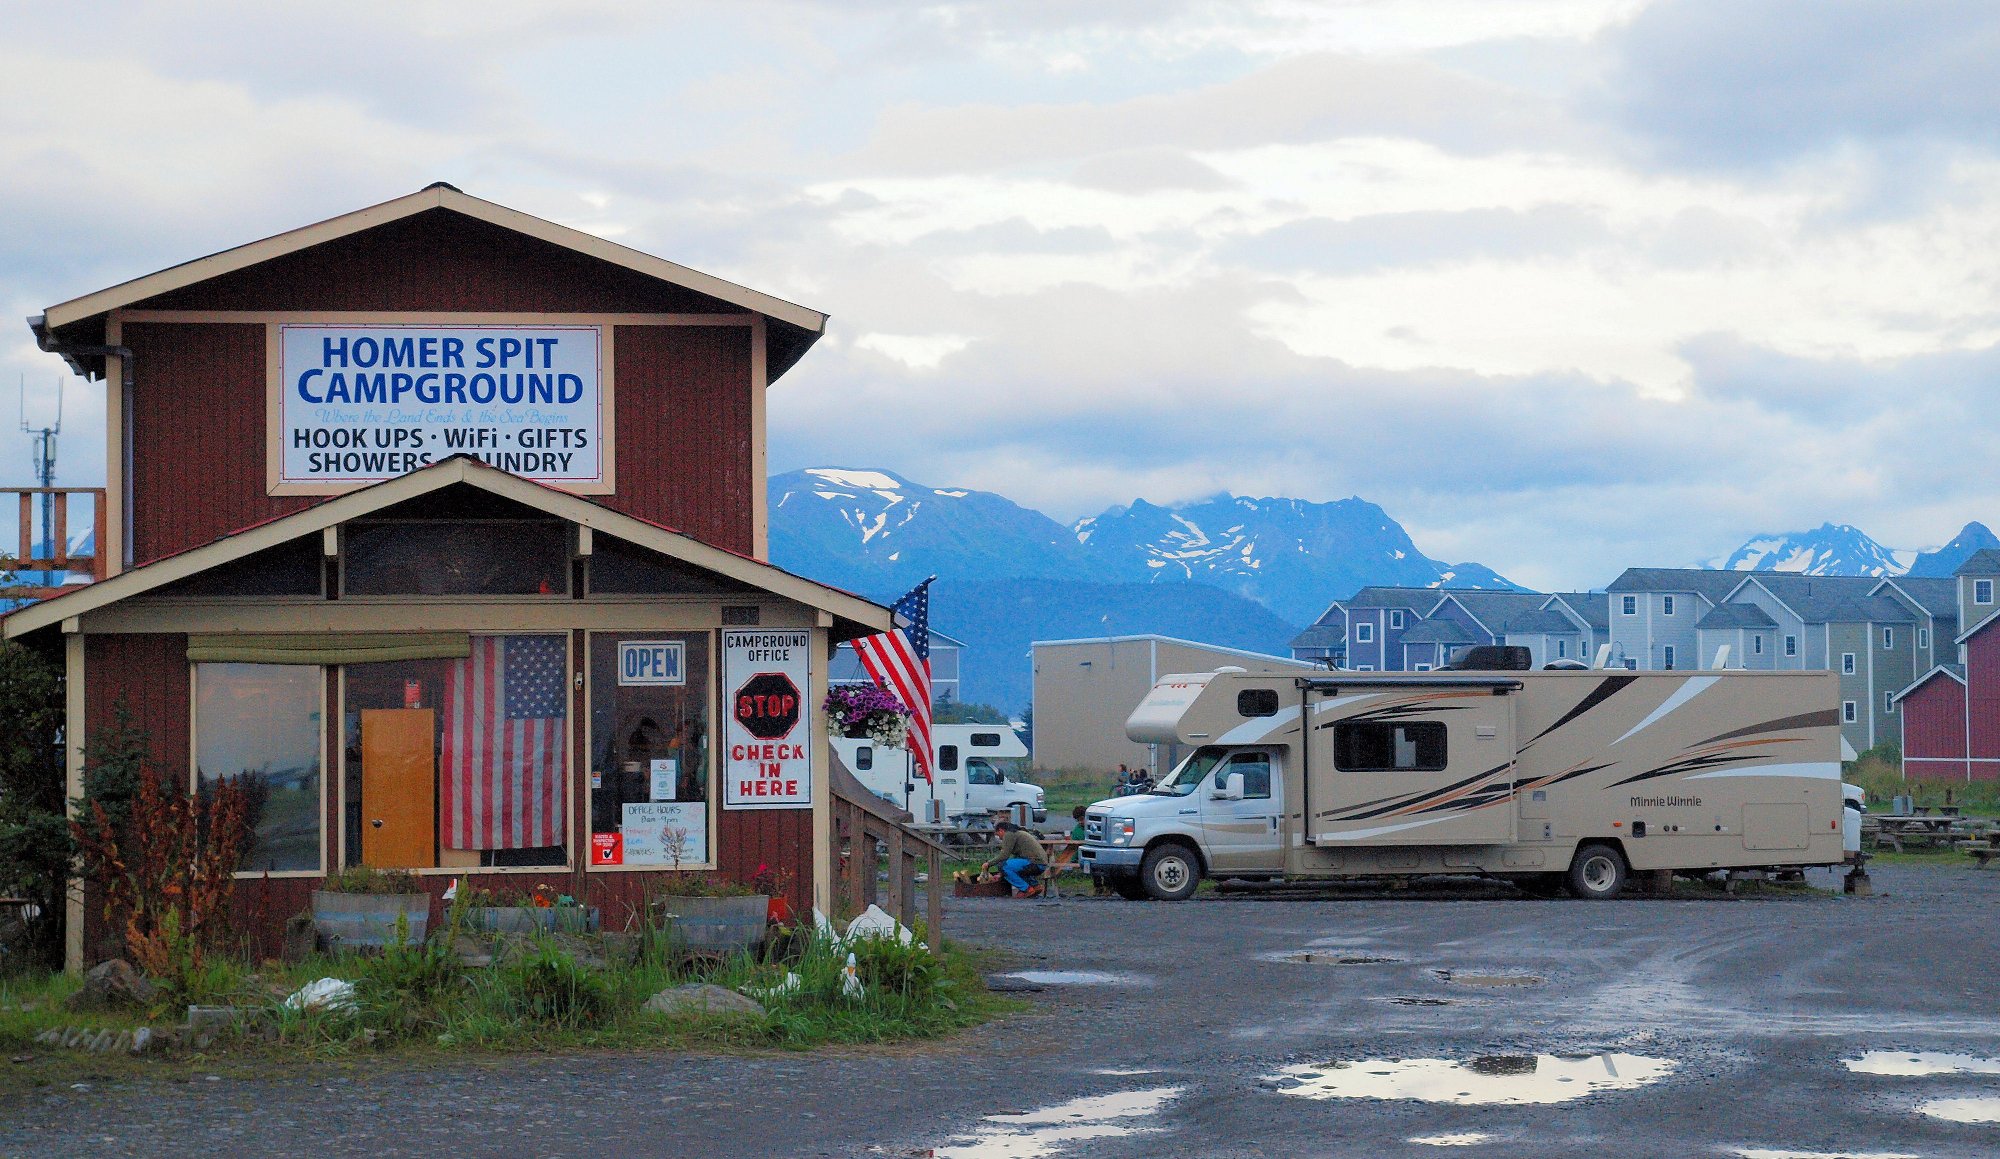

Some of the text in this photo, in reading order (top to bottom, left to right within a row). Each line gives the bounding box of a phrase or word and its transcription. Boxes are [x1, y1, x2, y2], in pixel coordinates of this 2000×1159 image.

[322, 336, 559, 369] HOMER SPIT
[297, 367, 584, 404] CAMPGROUND
[314, 408, 569, 425] Where the Land Ends & the Sea Begins
[293, 427, 588, 449] HOOK UPS WiFi GIFTS
[308, 452, 574, 472] SHOWERS UNDRY
[727, 635, 807, 648] CAMPGROUND
[625, 648, 678, 677] OPEN
[748, 649, 790, 661] OFFICE
[739, 694, 794, 718] STOP
[731, 744, 805, 761] CHECK
[759, 763, 781, 777] IN
[740, 780, 798, 796] HERE
[628, 805, 654, 814] OFFICE
[656, 805, 682, 814] HOURS
[1630, 795, 1702, 807] Minnie Winnie
